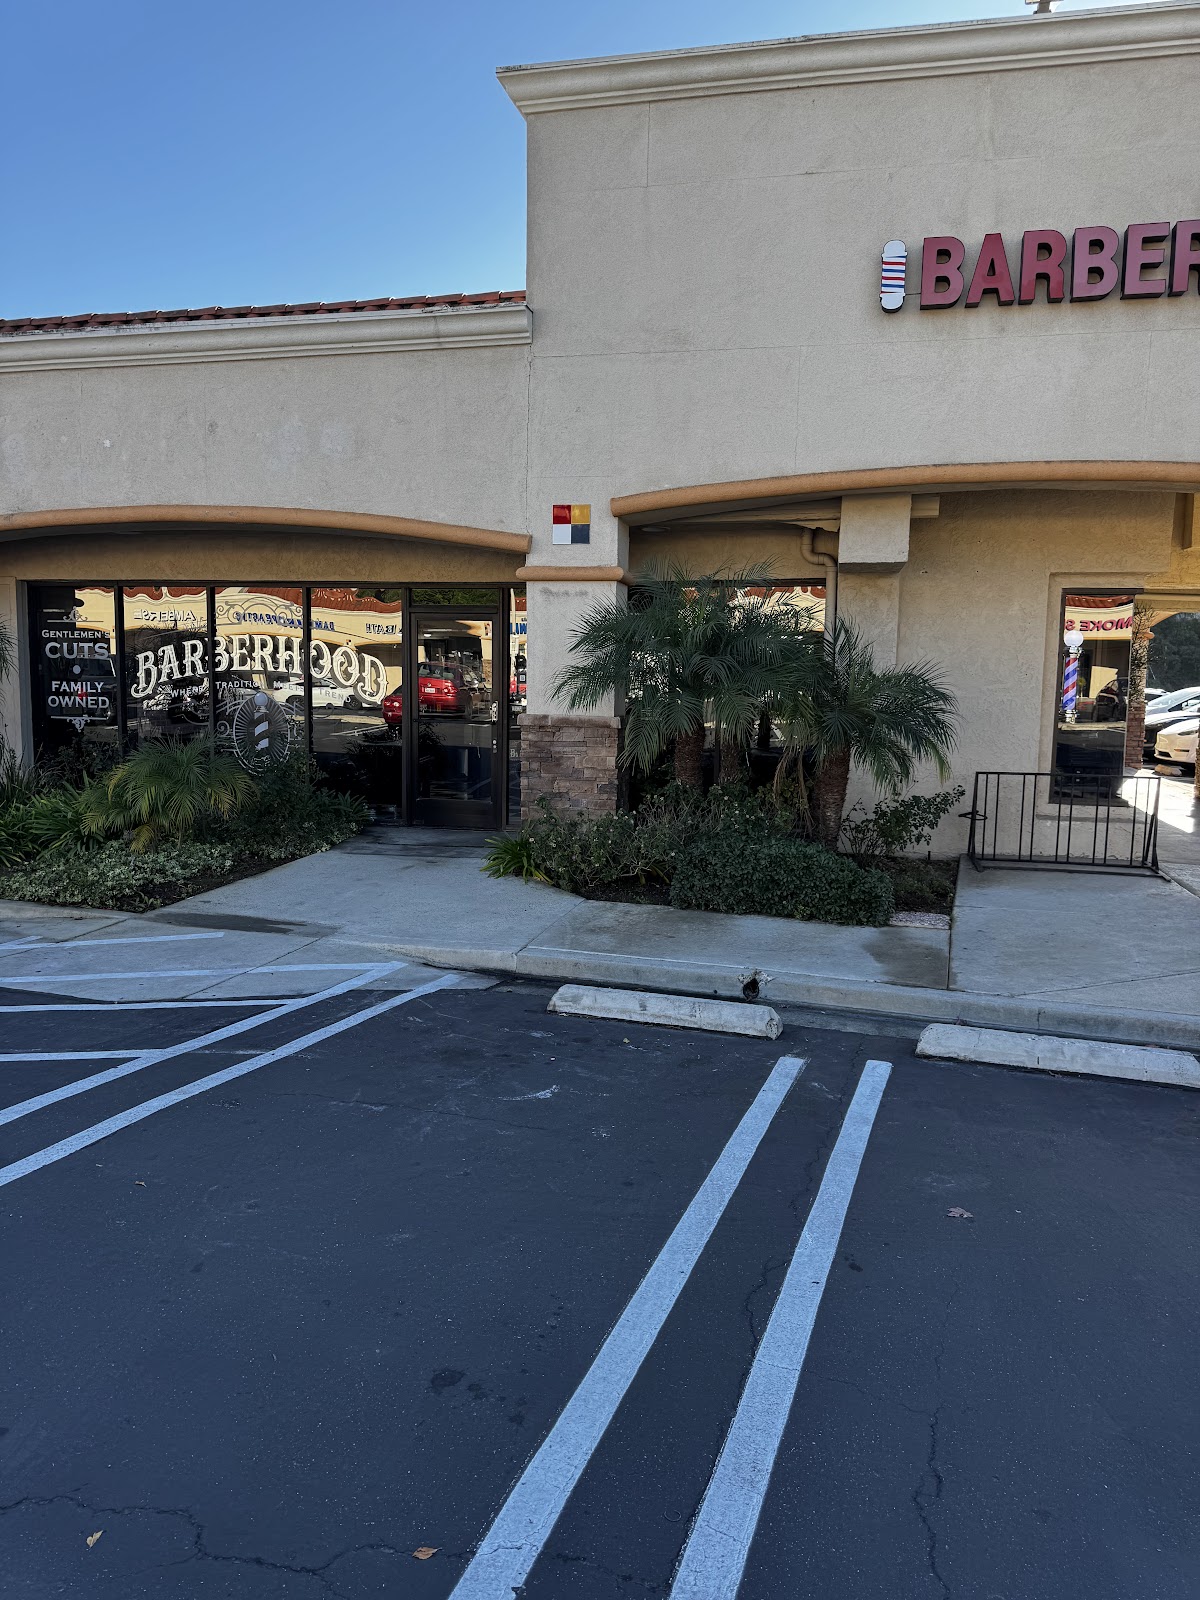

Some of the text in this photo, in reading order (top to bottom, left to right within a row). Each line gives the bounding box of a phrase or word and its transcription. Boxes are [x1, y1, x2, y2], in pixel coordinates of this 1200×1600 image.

[920, 219, 1200, 310] BARBER
[41, 629, 111, 639] GENTLEMEN'S
[45, 641, 109, 659] CUTS
[131, 633, 389, 706] BARBERHOOD
[51, 680, 104, 693] FAMILY
[215, 680, 263, 690] TRADITIO
[317, 686, 352, 703] TREND
[47, 696, 110, 709] OWNED
